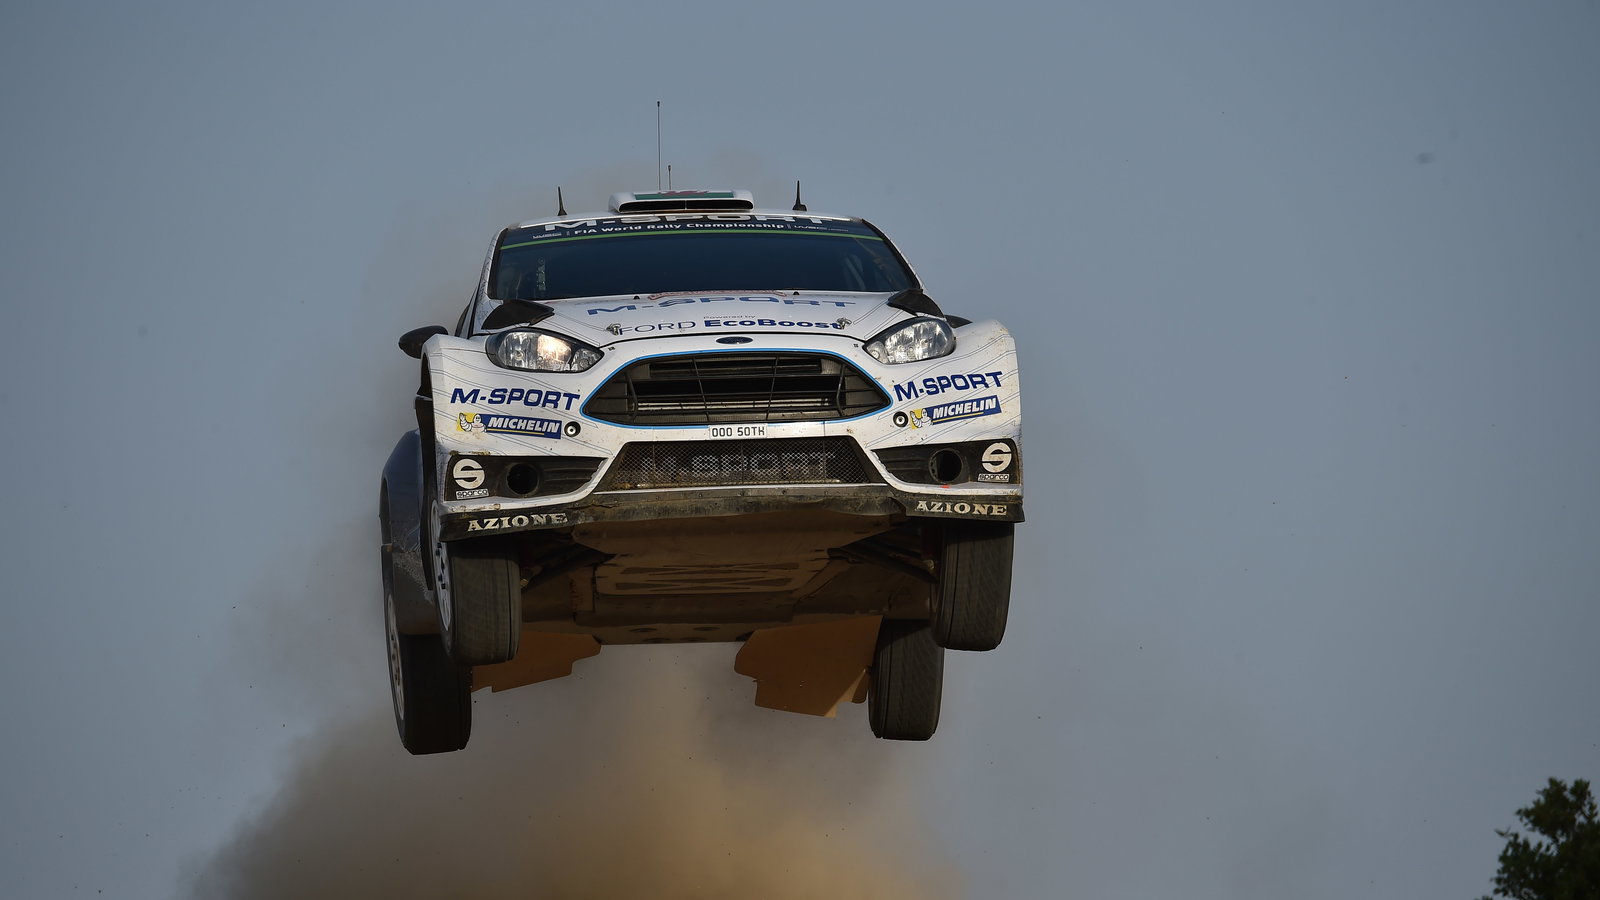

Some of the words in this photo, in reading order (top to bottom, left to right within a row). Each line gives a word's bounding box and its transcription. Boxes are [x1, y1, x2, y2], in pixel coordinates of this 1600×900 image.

[647, 223, 682, 231] Rally
[686, 222, 785, 230] Championship
[587, 297, 856, 315] M-SPORT
[619, 320, 696, 335] FORD
[704, 318, 845, 330] EcoBoost
[893, 370, 1003, 402] M-SPORT
[450, 388, 580, 411] M-SPORT
[932, 397, 997, 420] MICHELIN
[488, 417, 560, 434] MICHELIN
[978, 474, 1010, 482] sparco
[456, 489, 489, 499] sparco
[915, 500, 1008, 516] AZIONE
[467, 512, 568, 532] AZIONE
